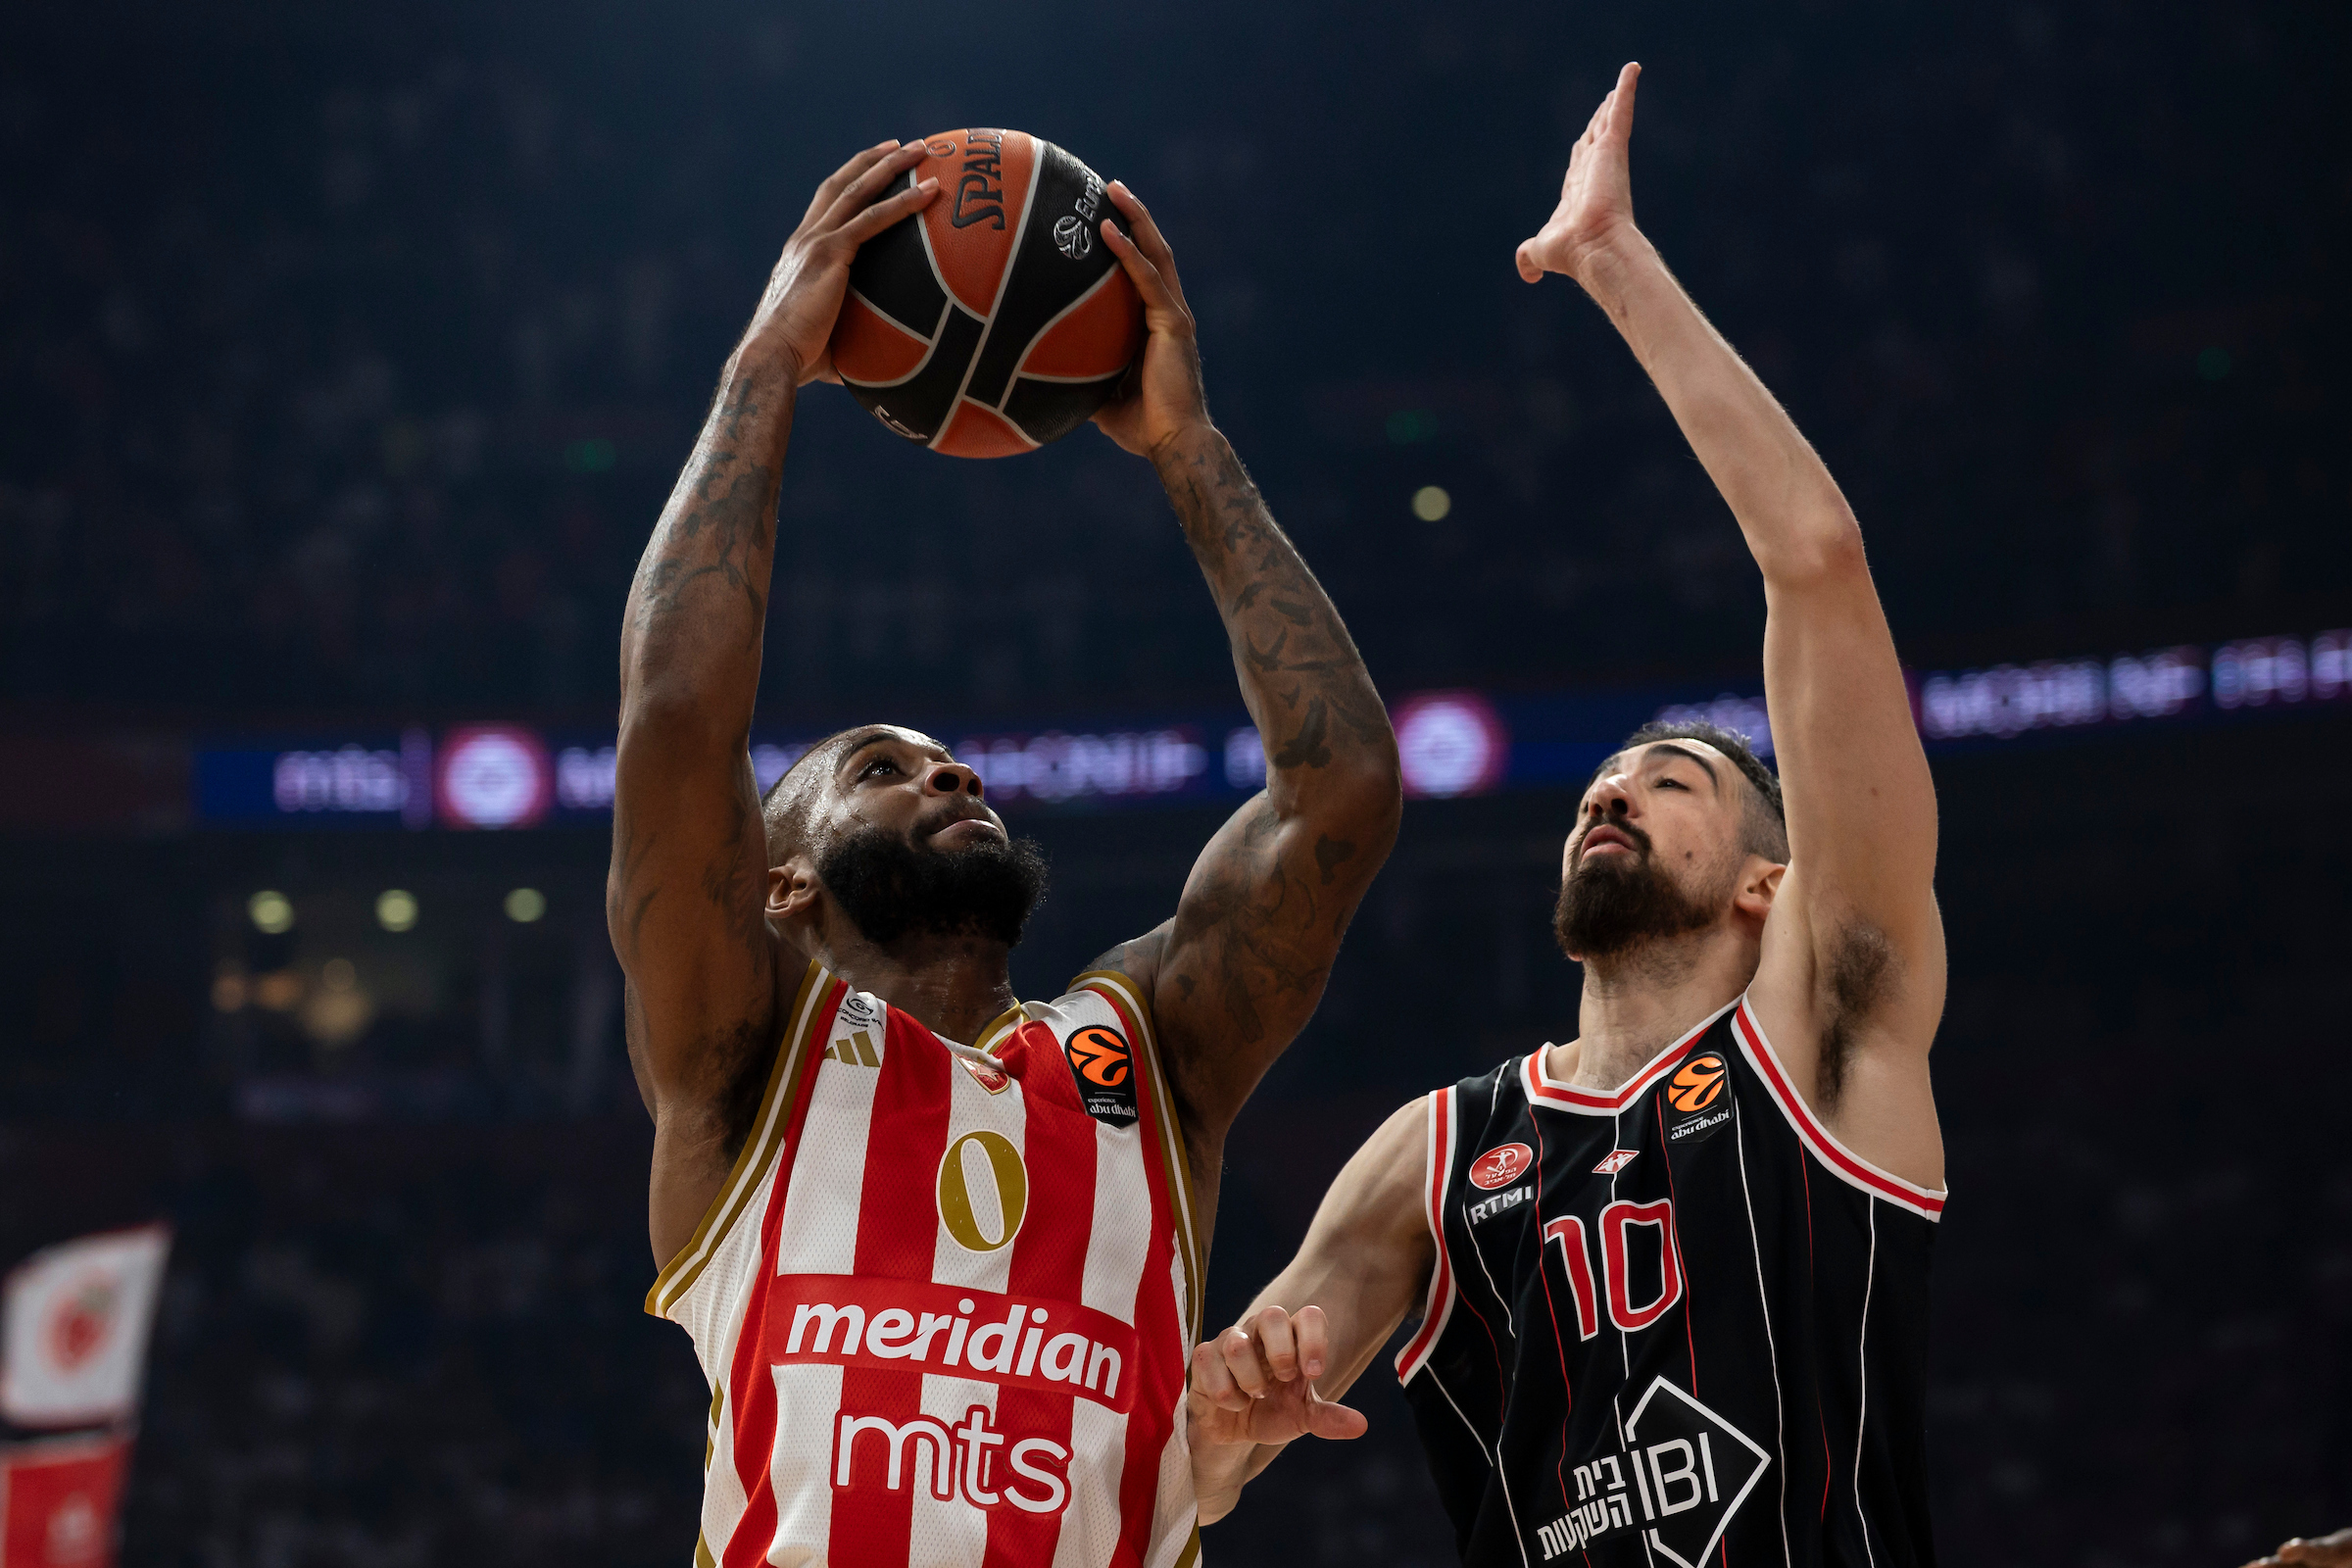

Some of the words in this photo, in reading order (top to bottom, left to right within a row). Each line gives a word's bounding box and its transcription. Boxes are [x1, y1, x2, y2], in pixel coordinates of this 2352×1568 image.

[1089, 1102, 1111, 1114] abu
[1110, 1103, 1137, 1118] dhabi
[1670, 1125, 1695, 1141] abu
[1694, 1108, 1731, 1131] dhabi
[936, 1130, 1029, 1253] 0
[1470, 1185, 1532, 1226] RTMI
[1544, 1199, 1684, 1343] 10
[785, 1298, 1122, 1399] meridian
[835, 1409, 1070, 1514] mts
[1573, 1454, 1627, 1502] בית
[1630, 1431, 1720, 1522] IBI
[1537, 1492, 1634, 1561] השקעות
